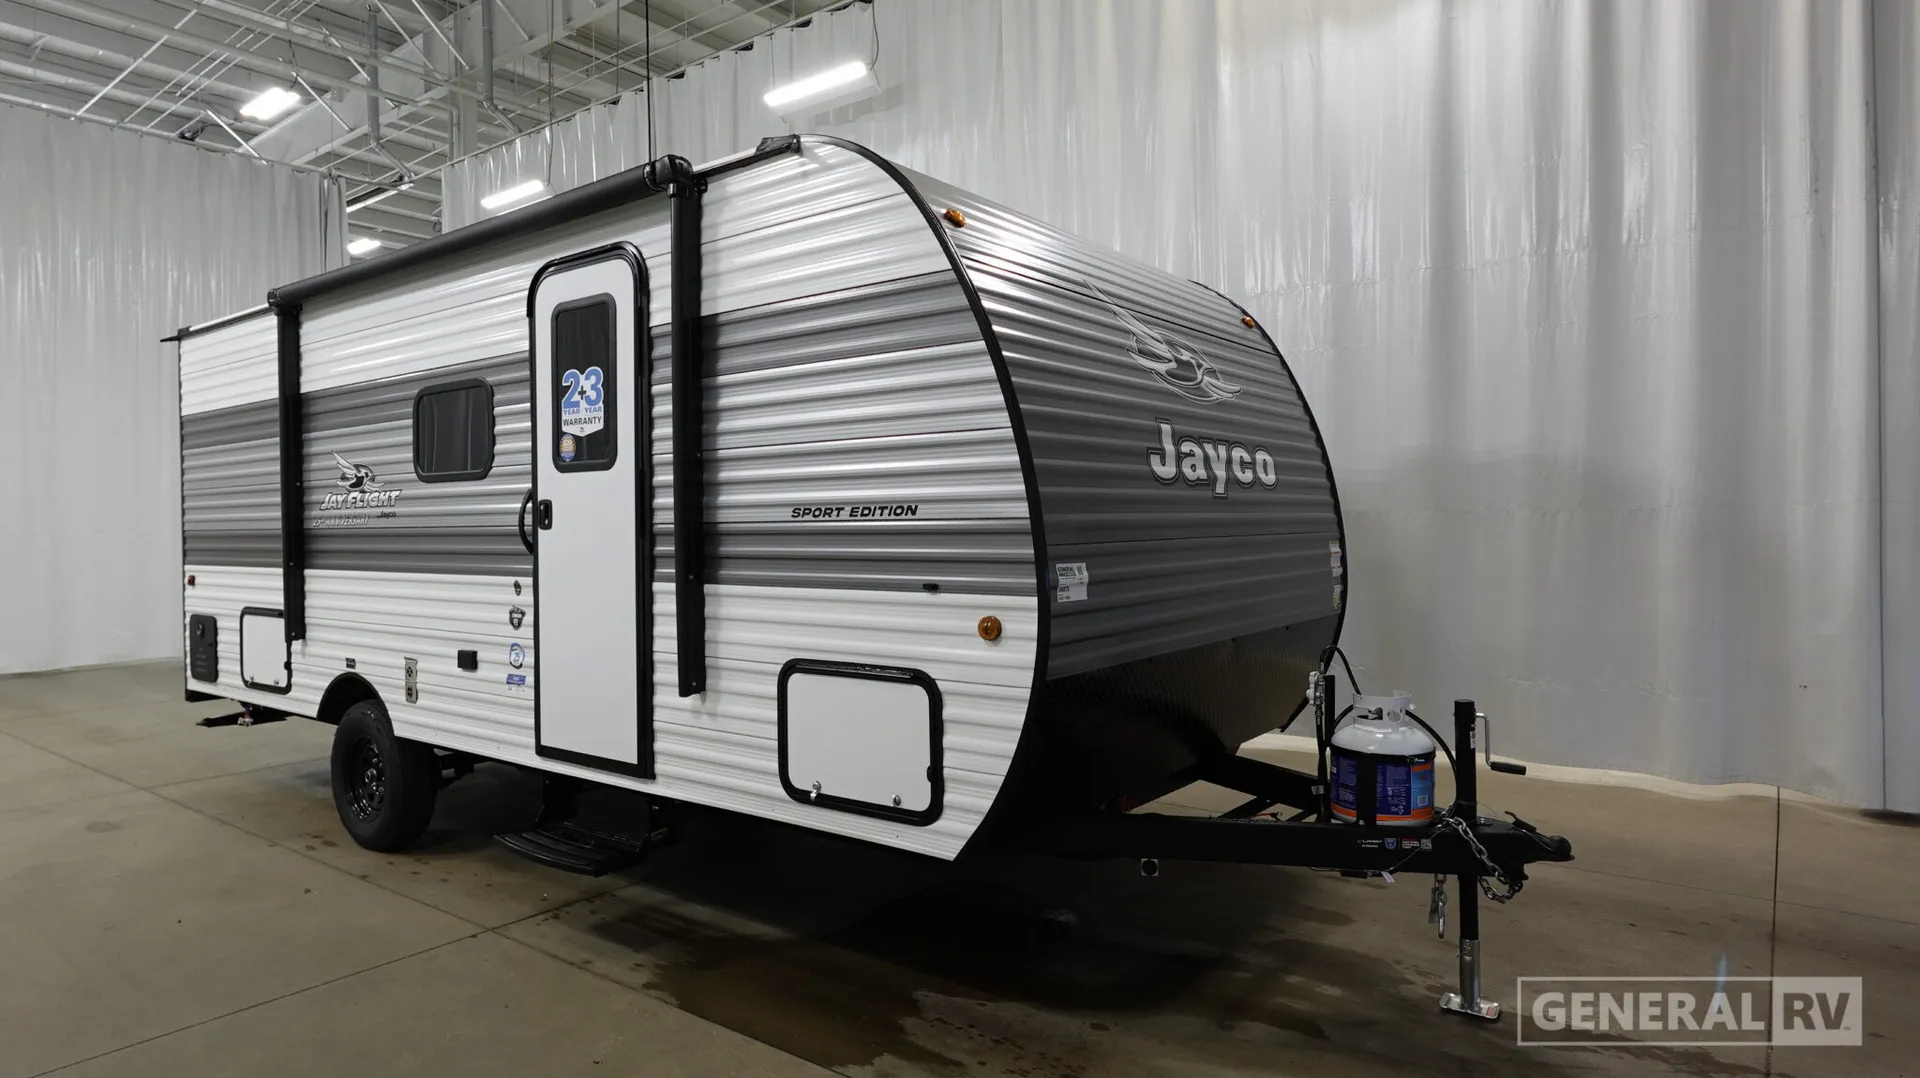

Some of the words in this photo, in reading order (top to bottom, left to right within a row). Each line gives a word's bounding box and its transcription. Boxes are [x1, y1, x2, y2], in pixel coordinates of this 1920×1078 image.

[563, 408, 580, 416] YEAR
[584, 406, 602, 414] YEAR
[563, 416, 602, 426] WARRANTY
[1147, 416, 1279, 499] Jayco
[319, 491, 348, 510] JAY
[346, 489, 403, 509] FLIGHT
[791, 506, 845, 518] SPORT
[849, 504, 919, 518] EDITION
